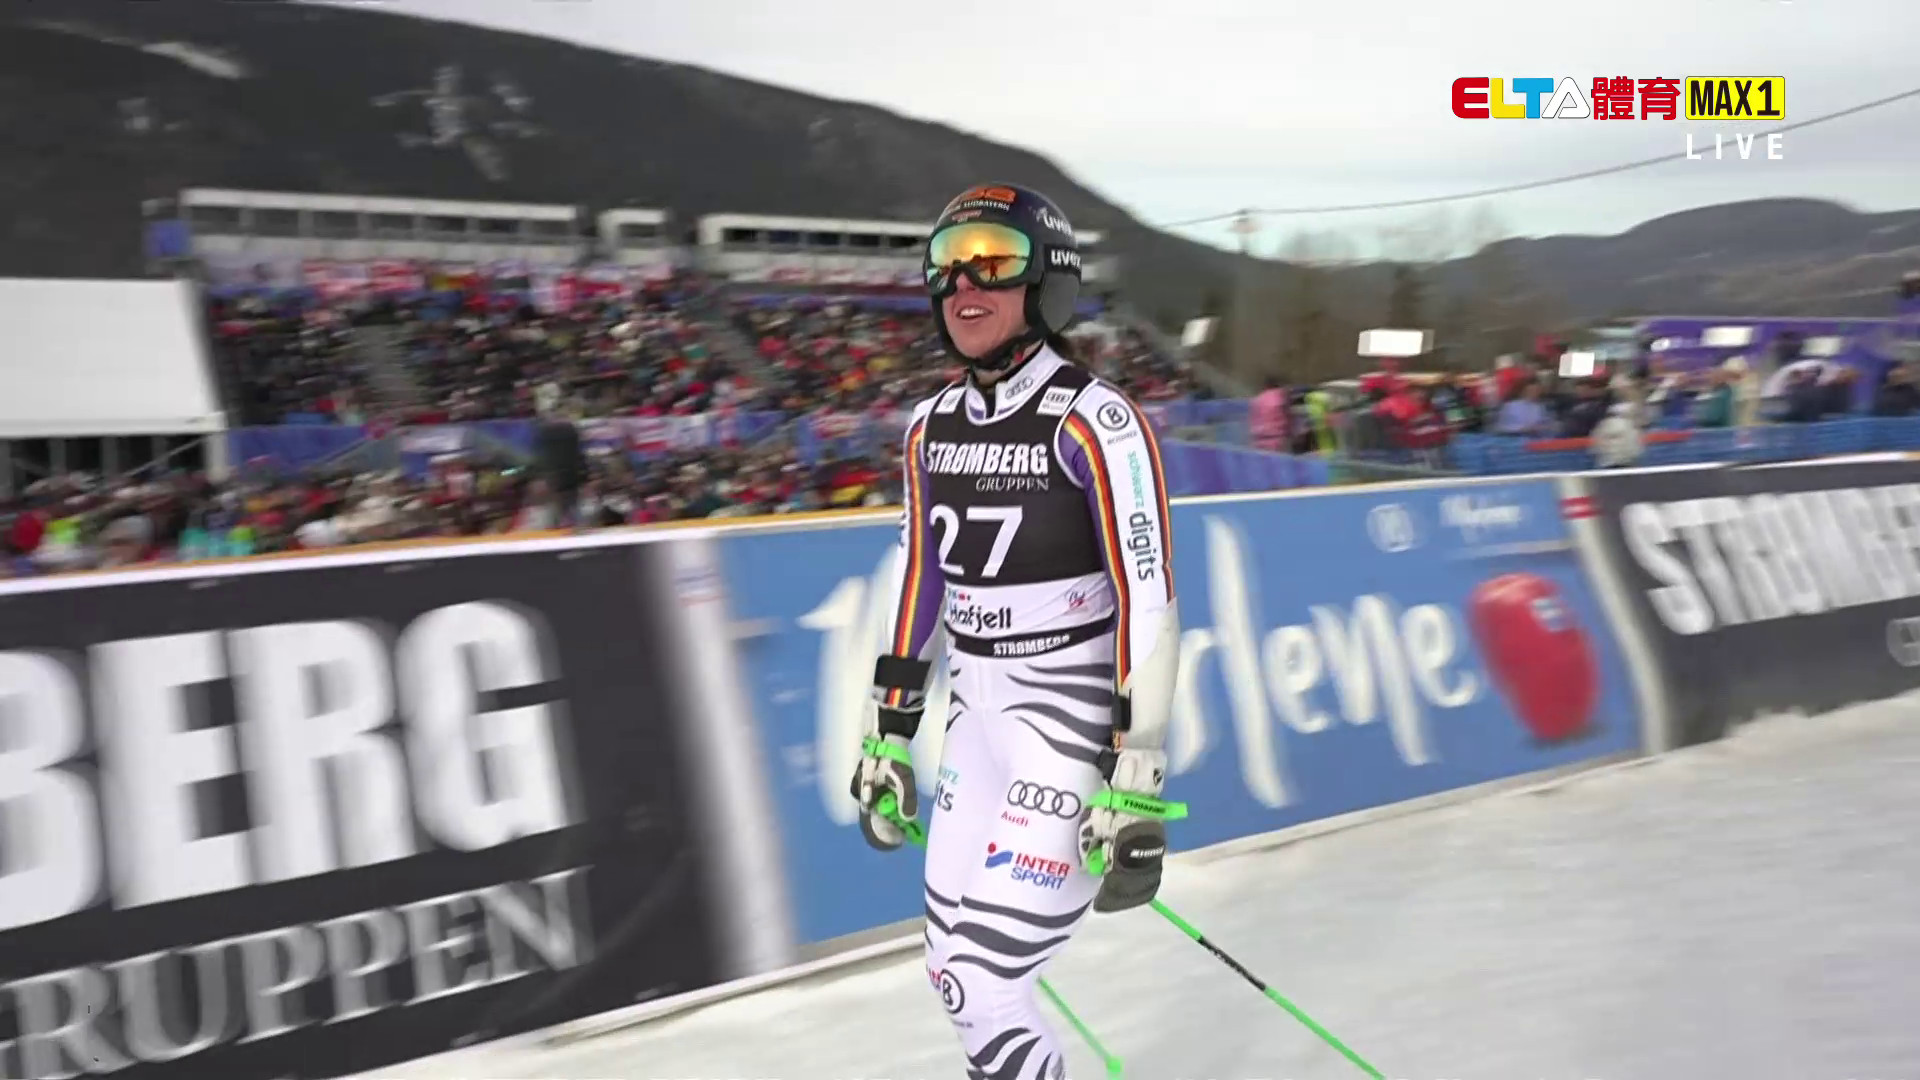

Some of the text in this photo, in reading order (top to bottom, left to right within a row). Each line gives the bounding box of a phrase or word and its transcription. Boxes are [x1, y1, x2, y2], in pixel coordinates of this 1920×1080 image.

[1051, 249, 1081, 268] uvex
[975, 475, 1050, 493] GRUPPEN
[930, 504, 1024, 579] 27
[1127, 511, 1157, 582] digits
[1001, 810, 1029, 828] Audi
[1015, 852, 1071, 878] INTER
[1010, 866, 1066, 891] SPORT
[0, 864, 594, 1080] RUPPEN
